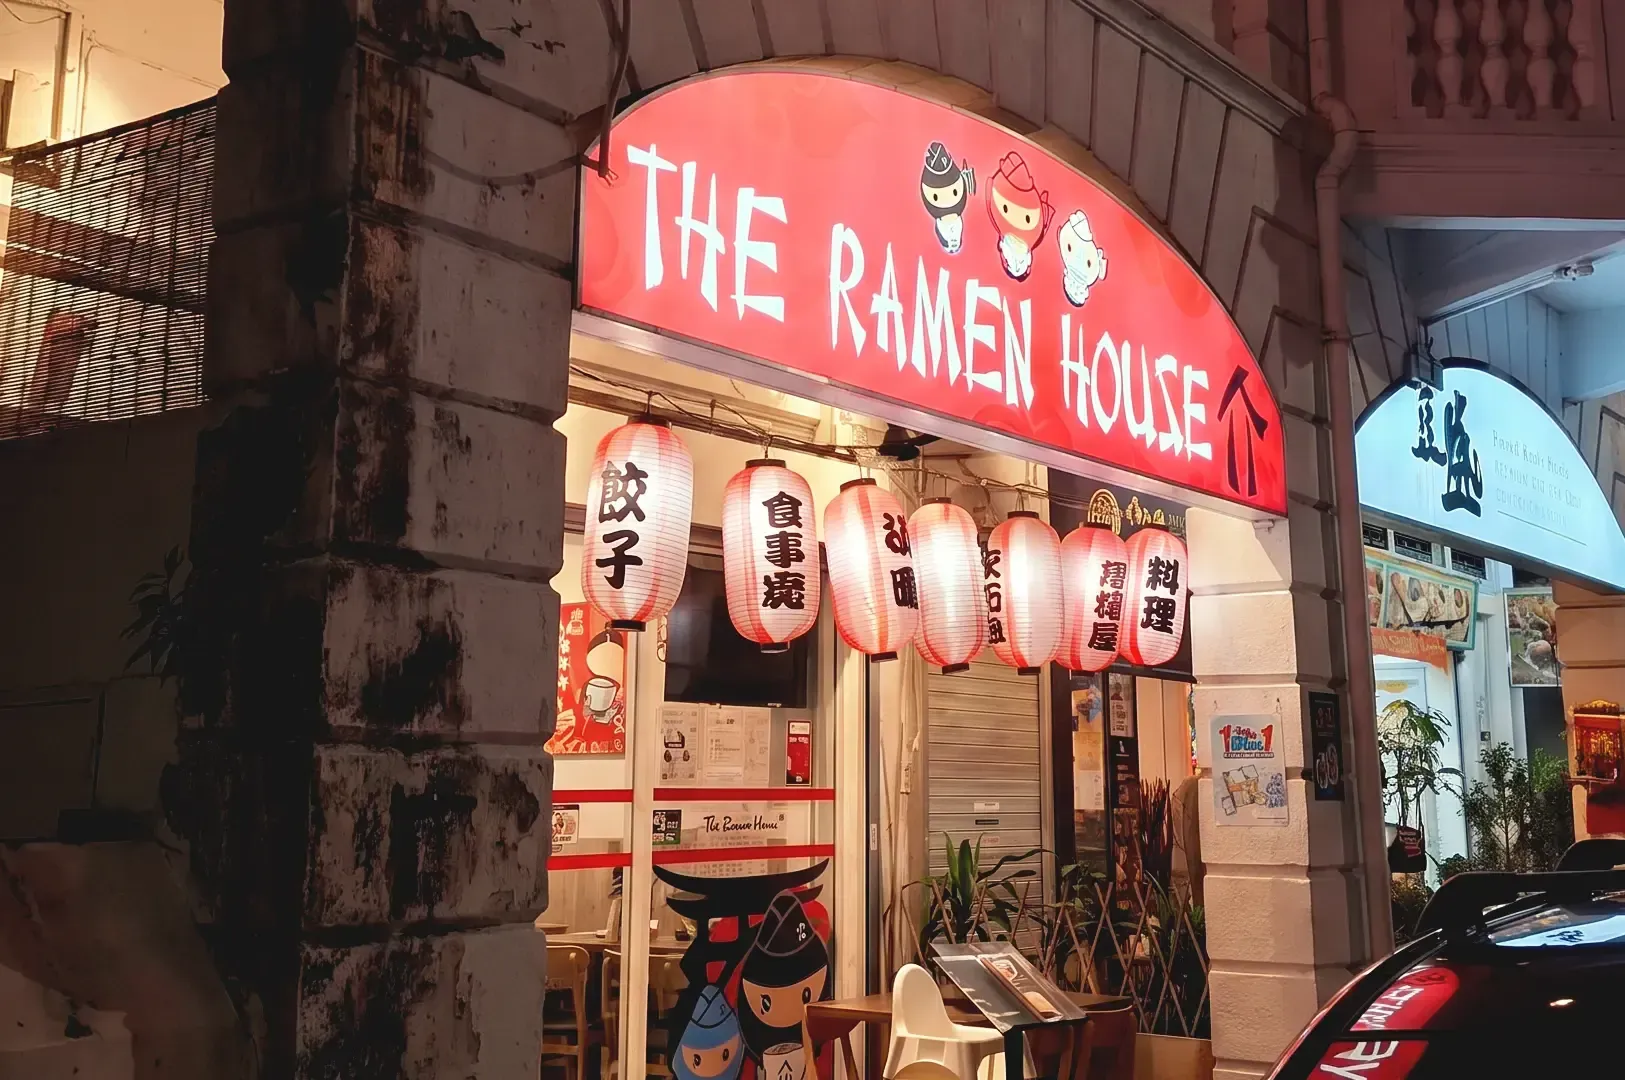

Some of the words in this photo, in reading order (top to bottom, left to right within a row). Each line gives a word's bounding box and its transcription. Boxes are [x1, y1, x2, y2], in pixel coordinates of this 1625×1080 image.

[627, 144, 787, 321] THE
[829, 223, 1034, 407] RAMEN
[1060, 314, 1212, 462] HOUSE
[596, 461, 648, 589] 餃子
[1141, 556, 1180, 634] 料理
